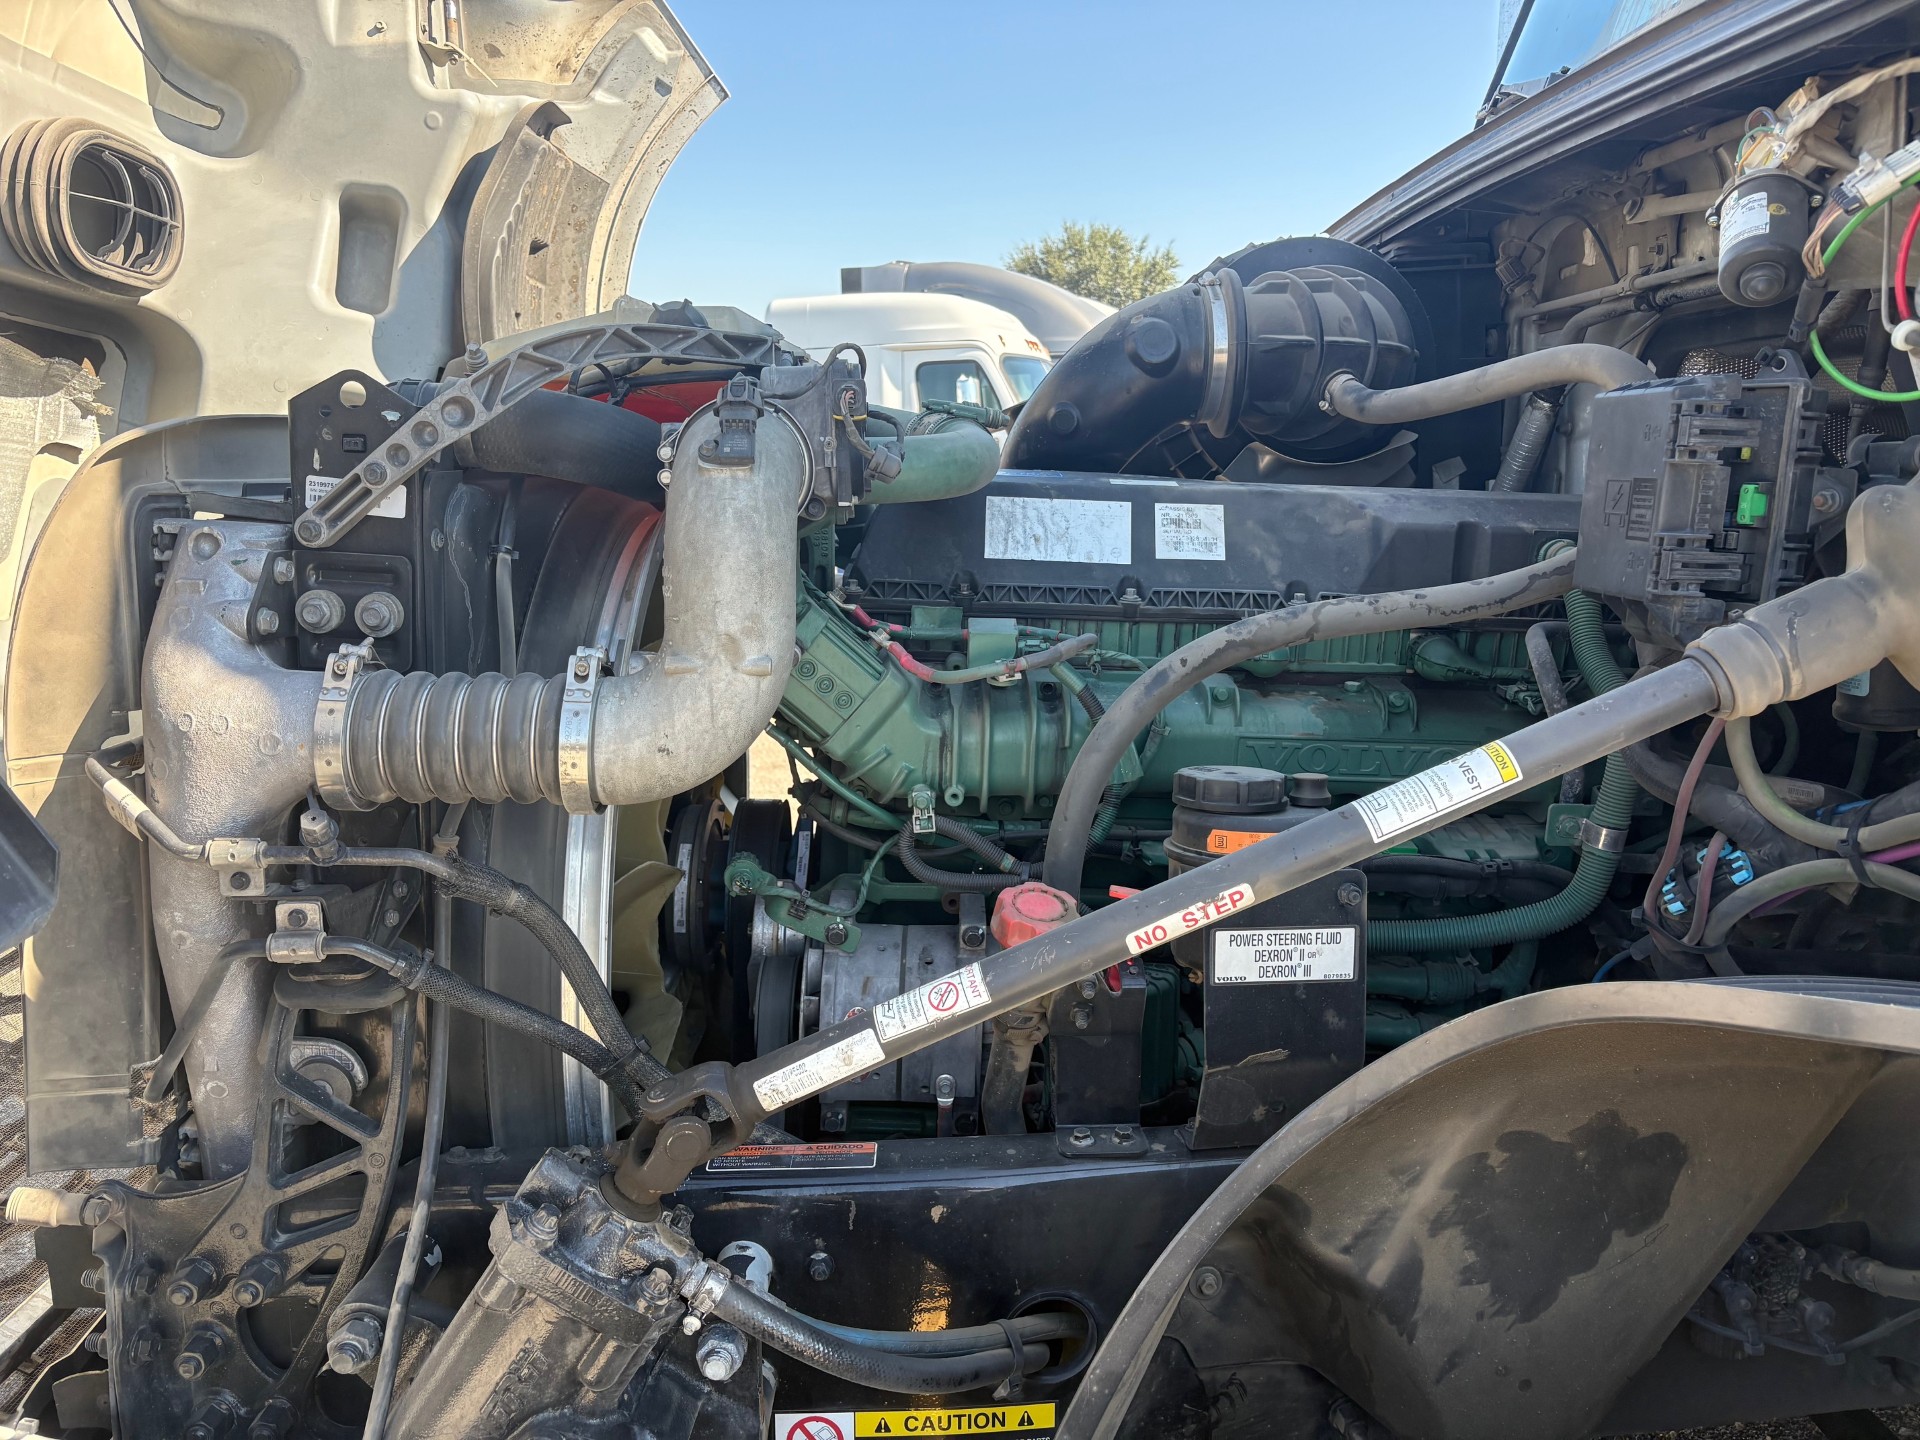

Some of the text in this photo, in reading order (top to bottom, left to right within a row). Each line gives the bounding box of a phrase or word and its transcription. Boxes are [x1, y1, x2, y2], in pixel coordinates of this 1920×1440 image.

[1458, 761, 1482, 790] VEST
[1134, 890, 1245, 950] NO STEP
[1229, 932, 1342, 947] POWER STEERING FLUID
[1303, 964, 1312, 978] III
[903, 1412, 1006, 1432] CAUTION
